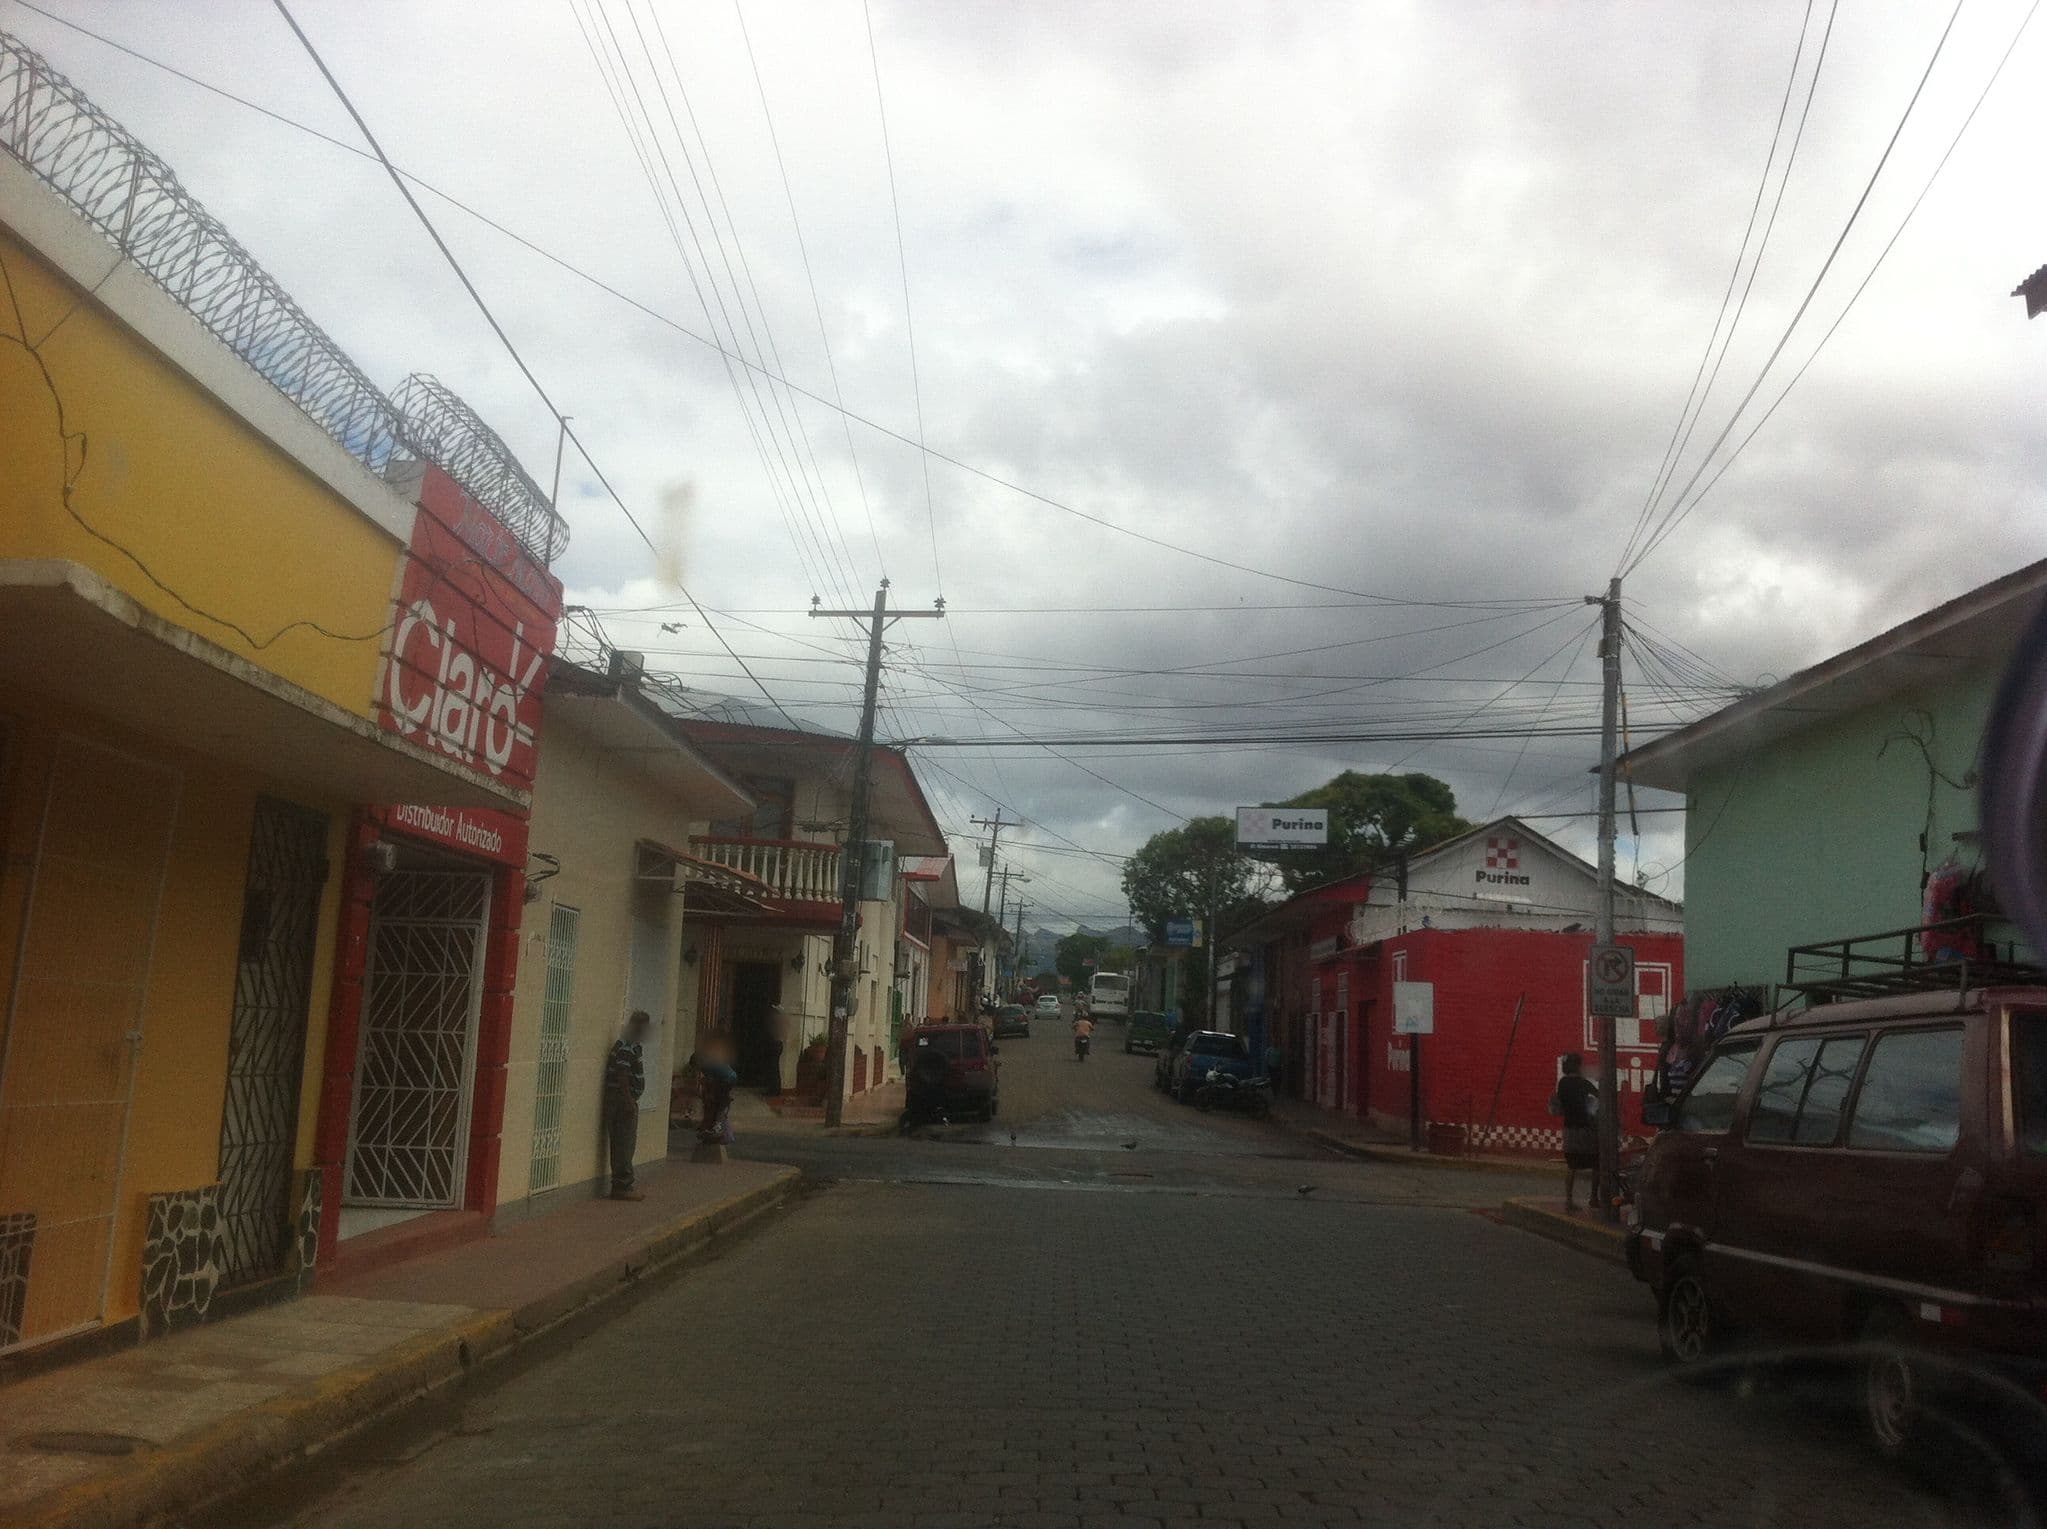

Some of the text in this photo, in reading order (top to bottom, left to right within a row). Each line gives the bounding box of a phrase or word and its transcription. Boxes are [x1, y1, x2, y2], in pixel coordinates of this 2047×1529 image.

[391, 599, 520, 776] Claro
[396, 804, 502, 854] Distribuidor Autorizado
[1272, 817, 1323, 830] Purina
[1476, 870, 1529, 885] Purina
